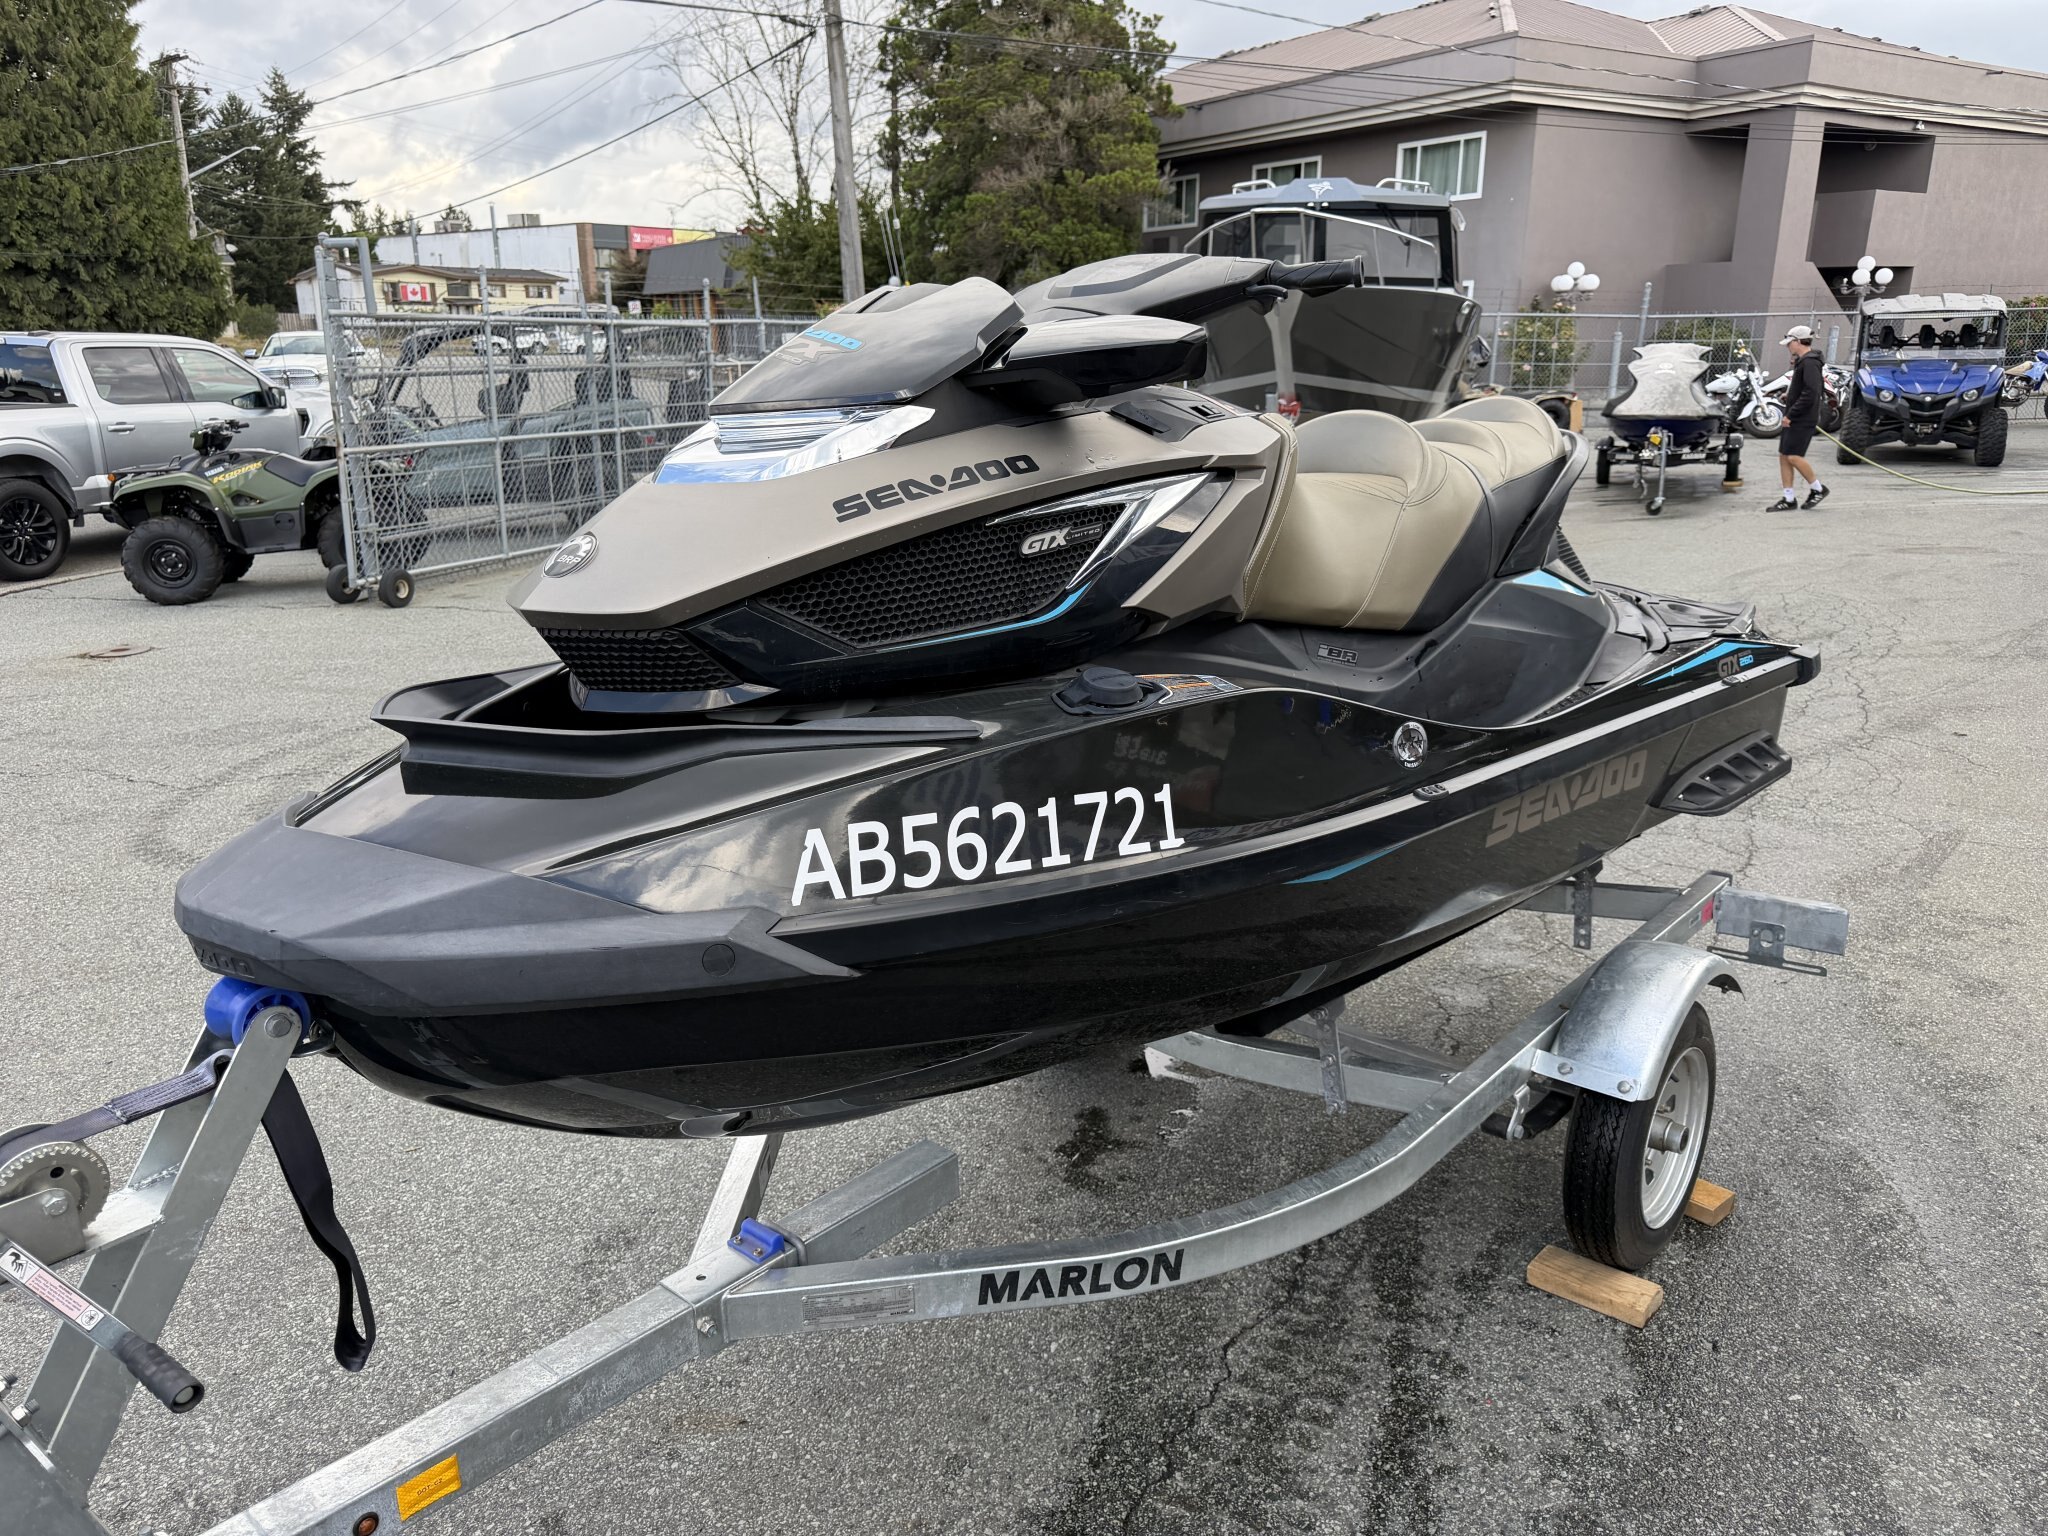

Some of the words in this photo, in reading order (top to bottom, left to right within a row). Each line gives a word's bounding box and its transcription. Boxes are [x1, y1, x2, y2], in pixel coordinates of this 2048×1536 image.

[1021, 526, 1072, 555] GTX
[1066, 528, 1101, 540] LIMITED
[556, 554, 582, 564] BRP
[1718, 654, 1741, 678] GTX
[791, 783, 1186, 906] AB5621721
[978, 1249, 1185, 1305] MARLON
